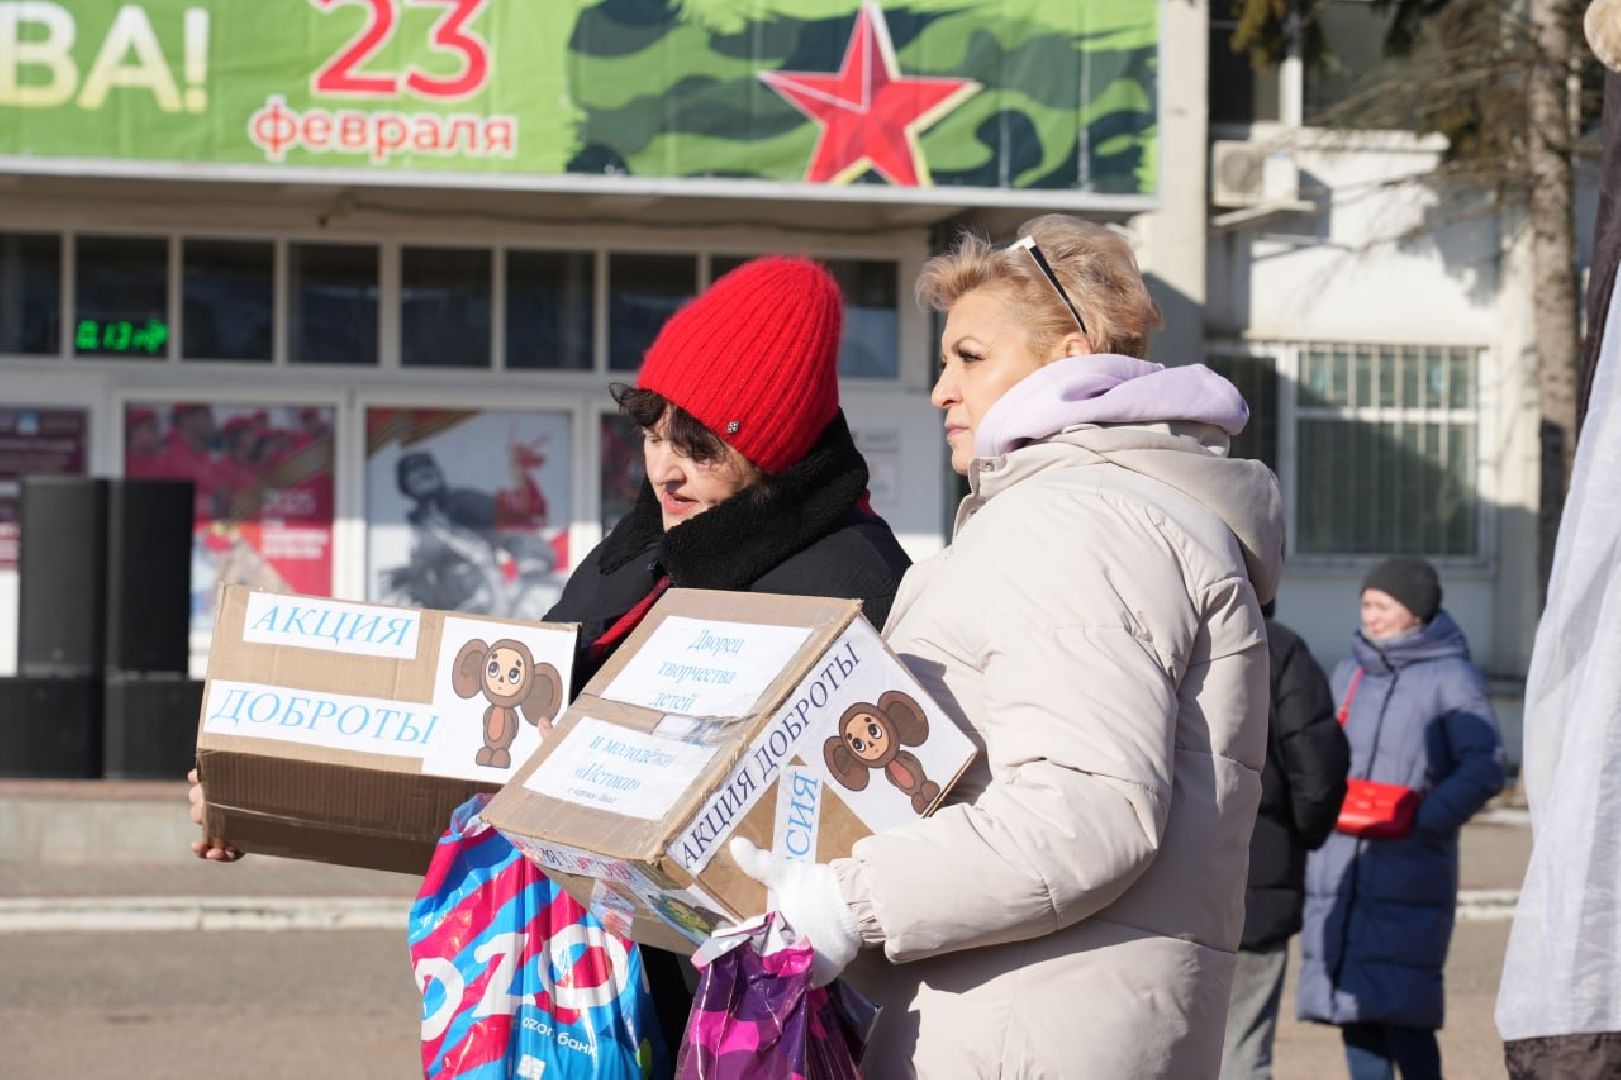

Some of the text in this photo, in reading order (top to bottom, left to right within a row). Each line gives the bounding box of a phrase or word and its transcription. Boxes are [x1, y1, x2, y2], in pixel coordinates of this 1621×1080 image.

[0, 4, 209, 113] ВА!
[309, 0, 490, 99] 23
[250, 97, 516, 162] февраля
[251, 604, 414, 647] АКЦИЯ
[687, 628, 745, 656] Дворец
[647, 690, 699, 712] детей
[656, 660, 738, 685] творчества
[209, 688, 440, 745] ДОБРОТЫ
[682, 641, 861, 870] АКЦИЯ ДОБРОТЫ
